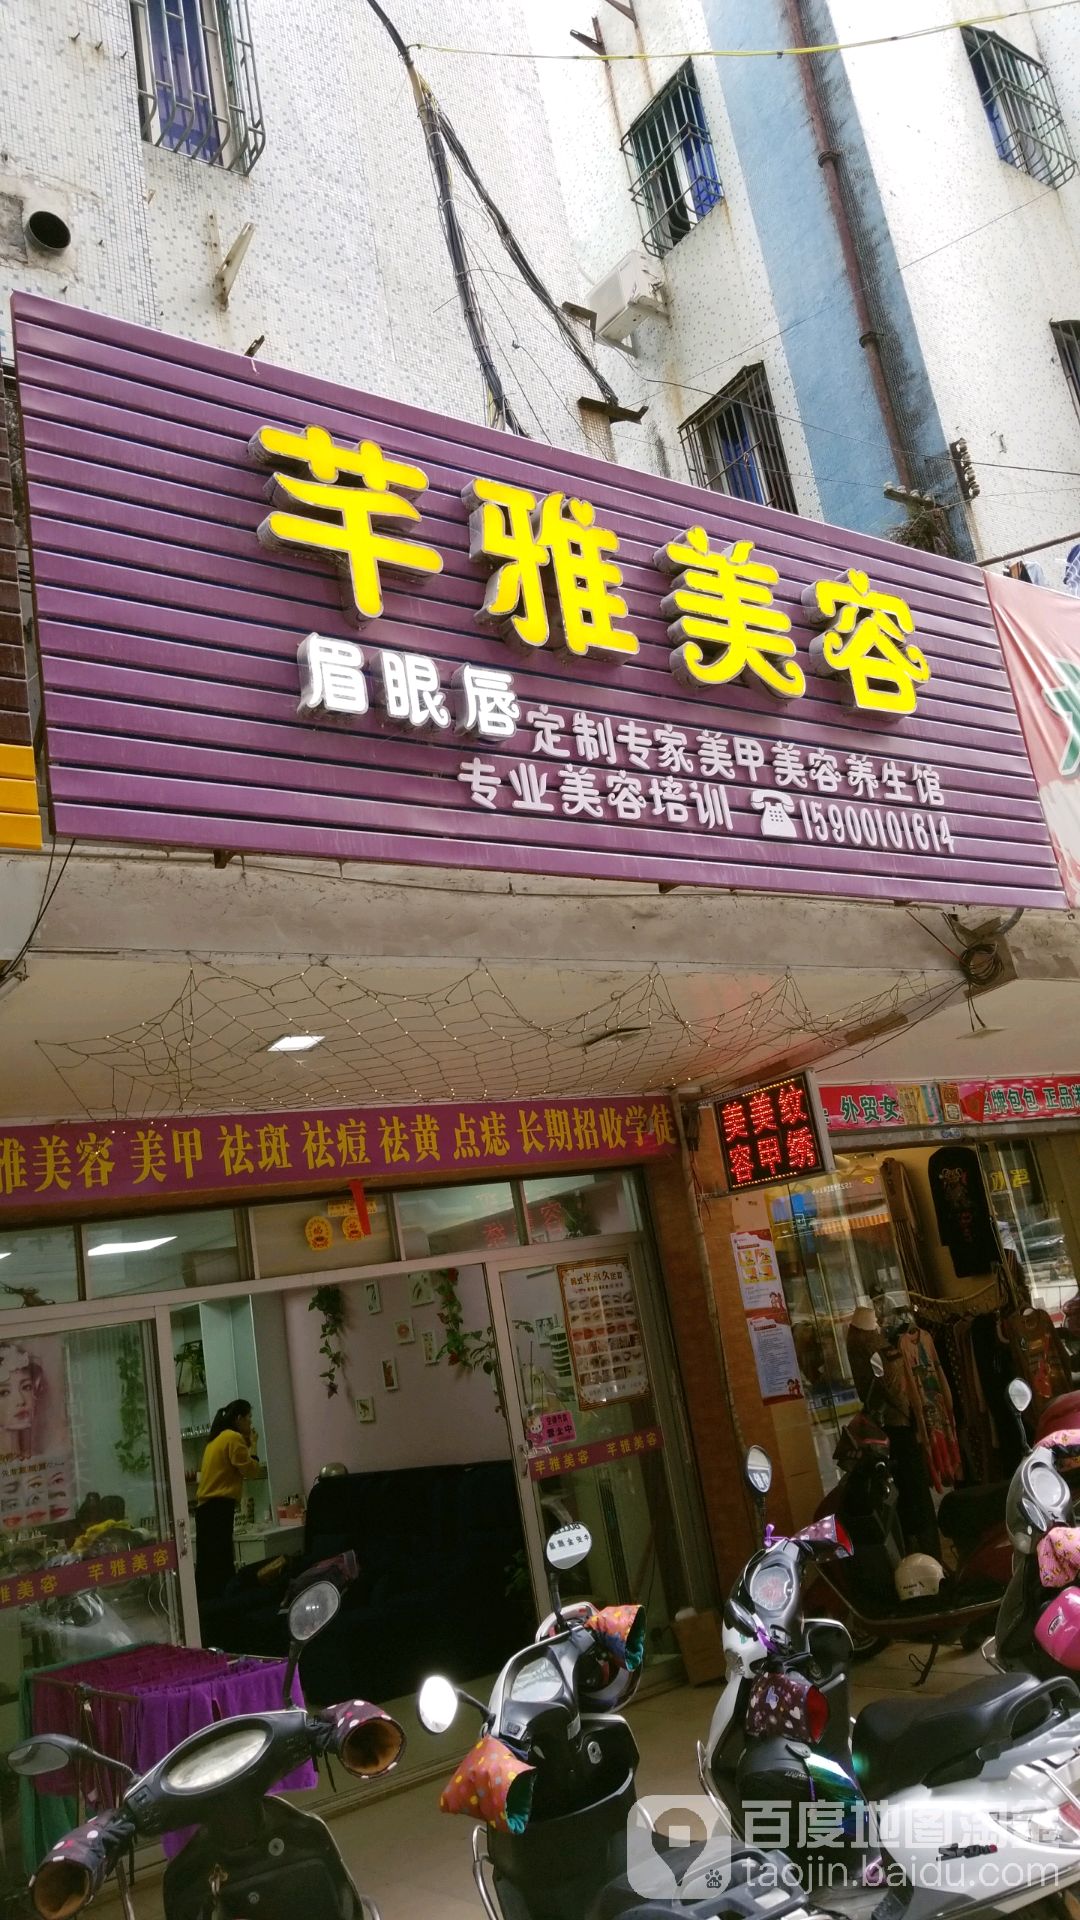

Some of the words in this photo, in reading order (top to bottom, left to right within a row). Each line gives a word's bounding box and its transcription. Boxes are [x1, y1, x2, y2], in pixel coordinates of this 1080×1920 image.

[254, 426, 930, 714] 芊雅美容
[298, 632, 520, 739] 眉眼唇
[526, 705, 944, 806] 定制专家美甲美容养生馆
[457, 757, 733, 831] 专业美容培训
[800, 799, 955, 853] 15900101614
[130, 1128, 203, 1185] 美甲
[217, 1123, 293, 1176] 祛斑
[301, 1118, 371, 1170] 祛痘
[378, 1113, 441, 1164] 祛黄
[453, 1110, 511, 1160] 点痣
[517, 1103, 678, 1154] 长期招收学徒
[722, 1101, 754, 1183] 美容
[749, 1093, 781, 1175] 美甲
[535, 1448, 590, 1474] 芊雅美容
[606, 1431, 657, 1457] 芊雅美容
[88, 1548, 169, 1582] 芊雅美容
